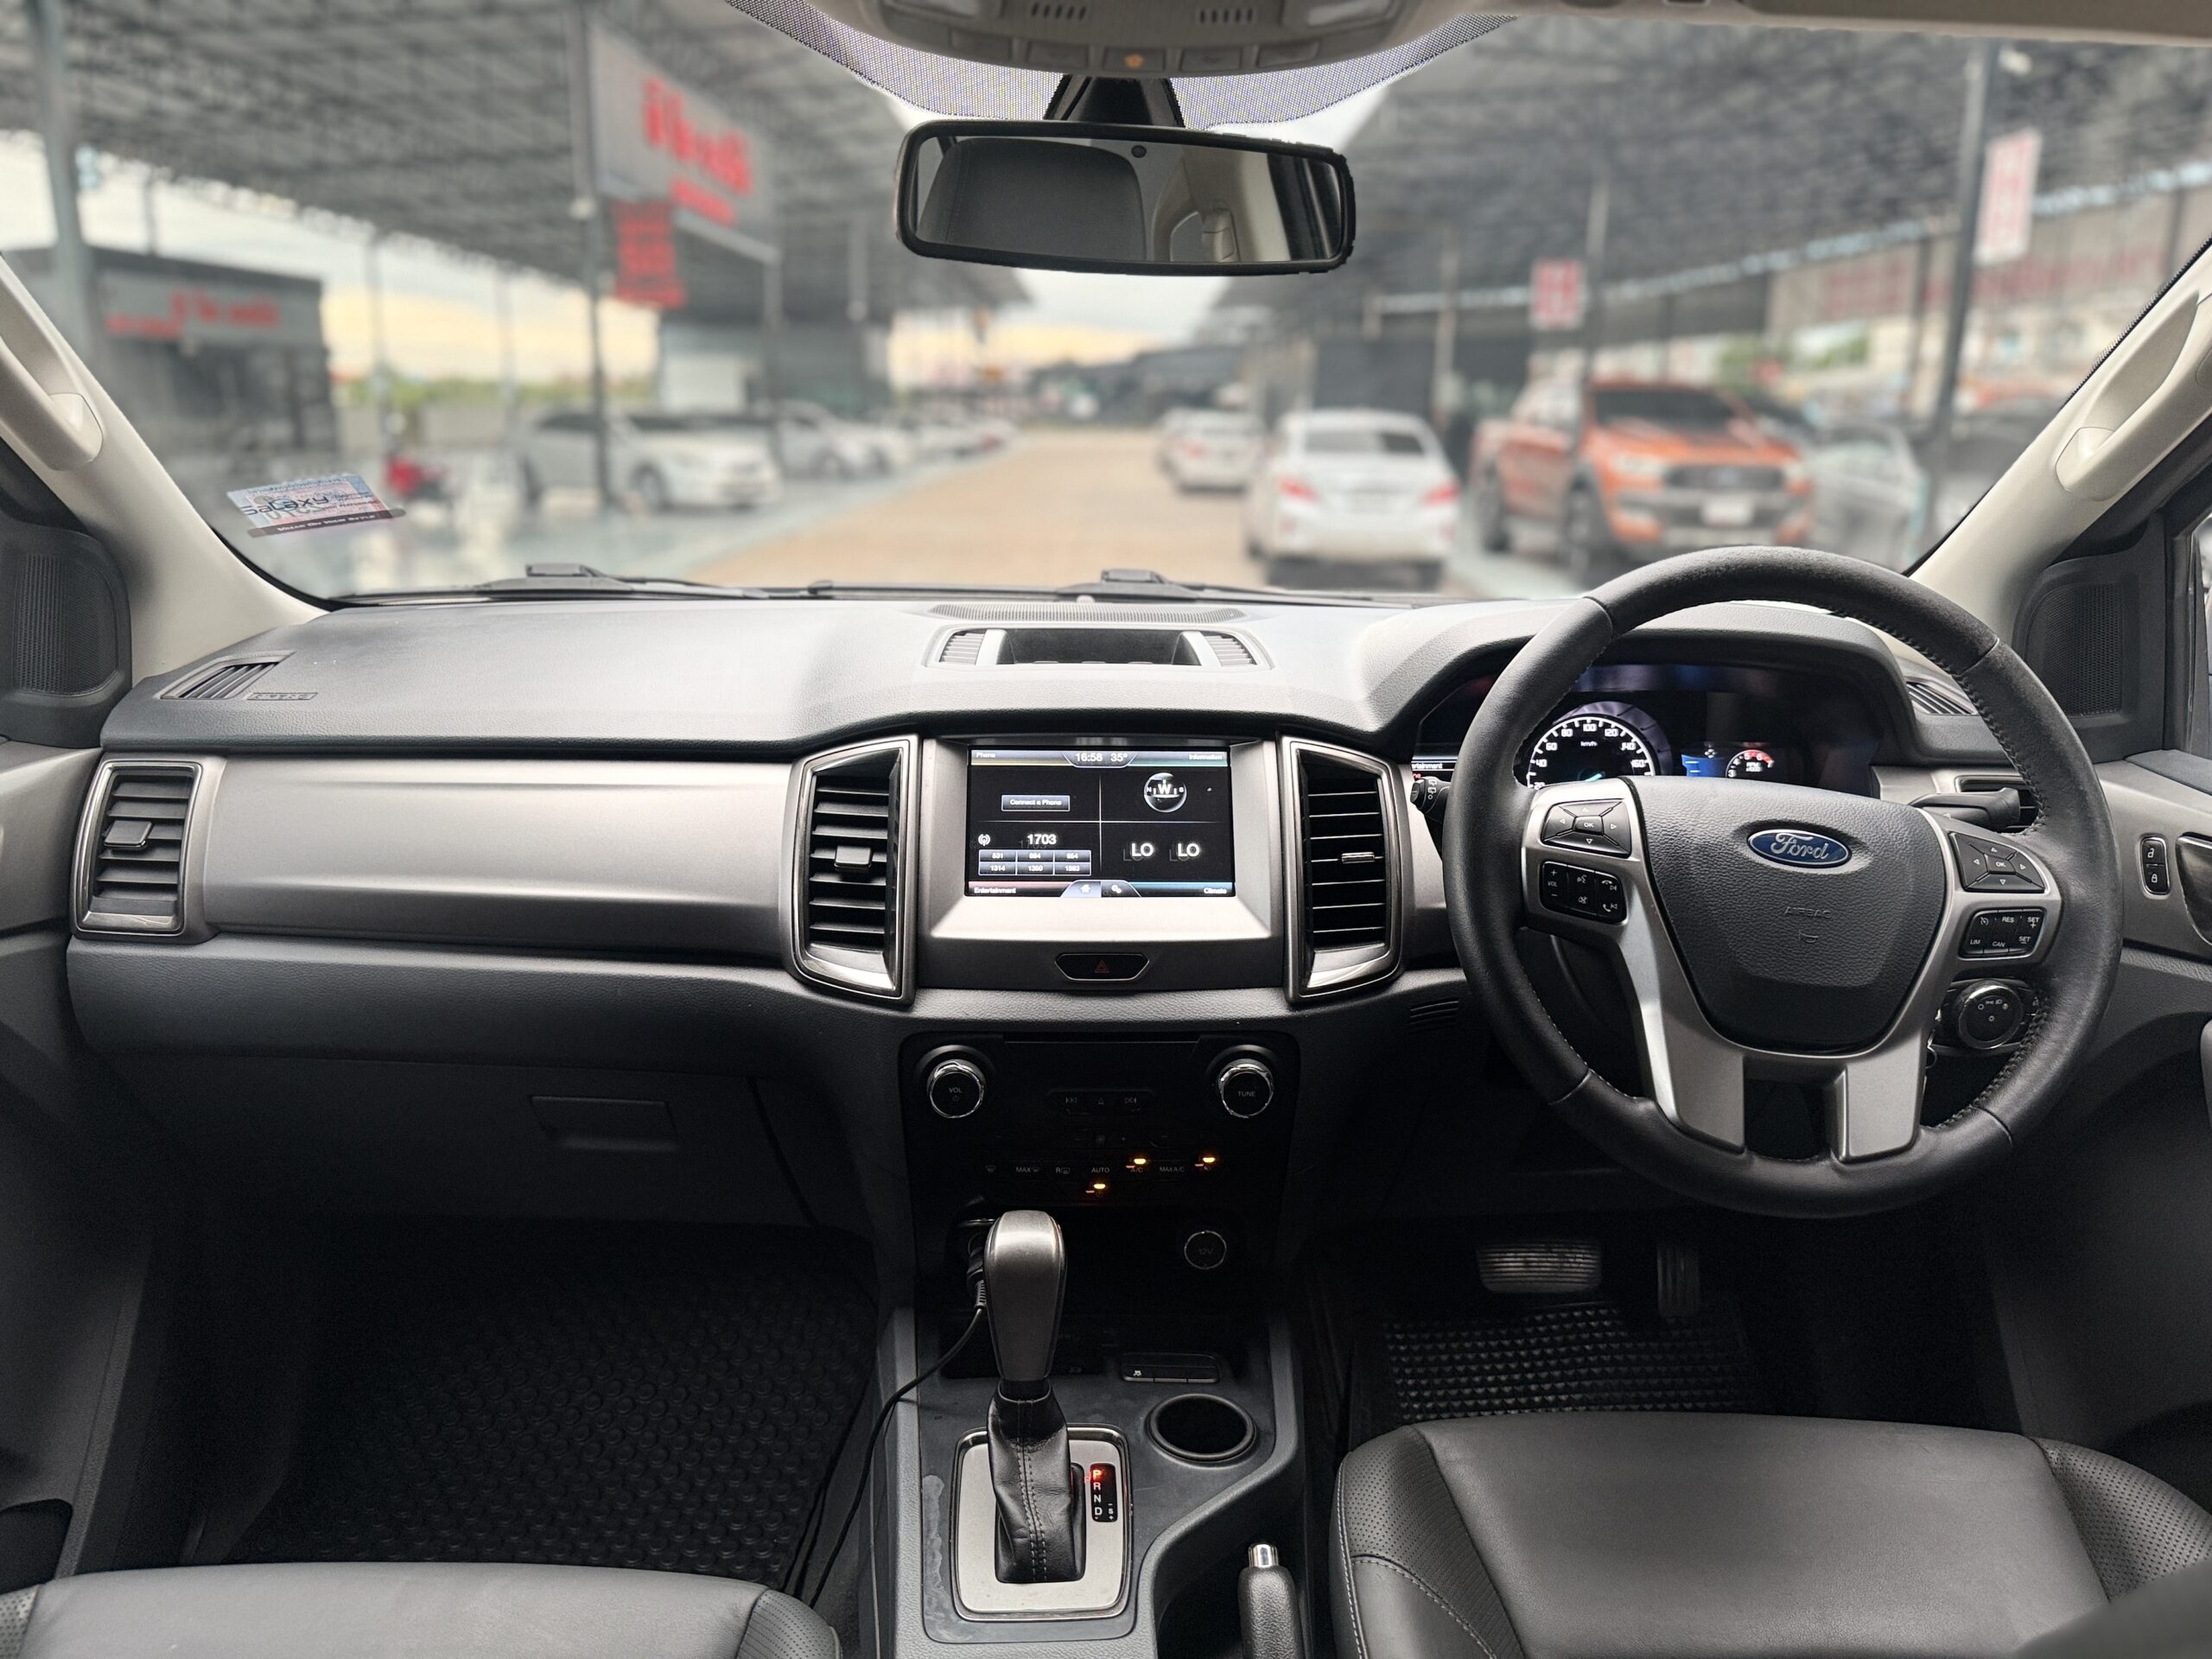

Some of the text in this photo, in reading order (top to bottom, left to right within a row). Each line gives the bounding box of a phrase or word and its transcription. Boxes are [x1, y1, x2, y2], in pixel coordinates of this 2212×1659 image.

[1583, 723, 1597, 732] 100
[1560, 728, 1573, 737] 80
[1605, 728, 1618, 737] 120
[1546, 742, 1557, 751] 60
[1621, 742, 1636, 751] 140
[1075, 753, 1103, 762] 16:58
[1535, 760, 1548, 768] 40
[1631, 760, 1646, 768] 160
[1728, 769, 1737, 778] 3
[1158, 784, 1173, 794] W
[1027, 834, 1057, 845] 1703
[1131, 842, 1200, 857] LO LO
[1770, 833, 1829, 860] Ford
[1092, 1470, 1102, 1479] P
[1093, 1482, 1101, 1491] R
[1093, 1494, 1102, 1503] N
[1094, 1506, 1103, 1516] D
